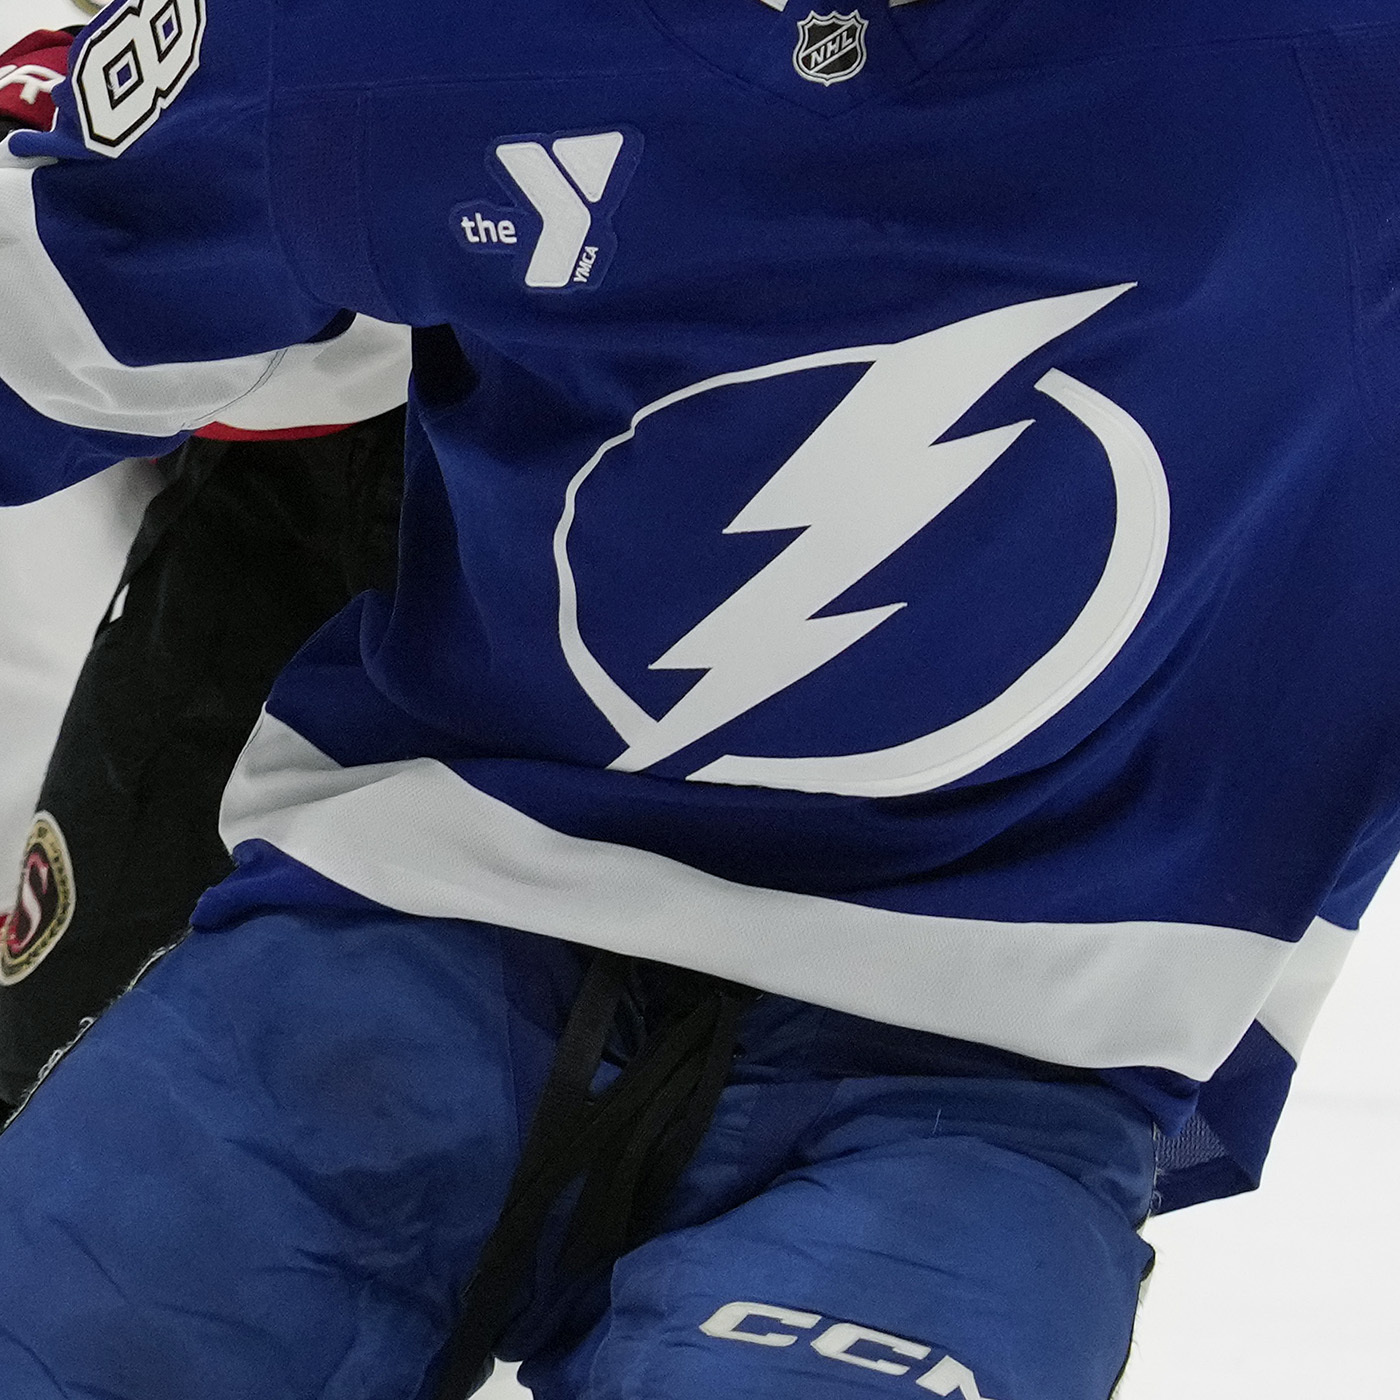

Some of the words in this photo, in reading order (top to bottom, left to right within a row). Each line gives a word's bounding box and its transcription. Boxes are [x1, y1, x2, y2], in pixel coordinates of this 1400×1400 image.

[810, 30, 854, 68] NHL
[461, 212, 518, 245] the
[573, 245, 599, 284] YMCA
